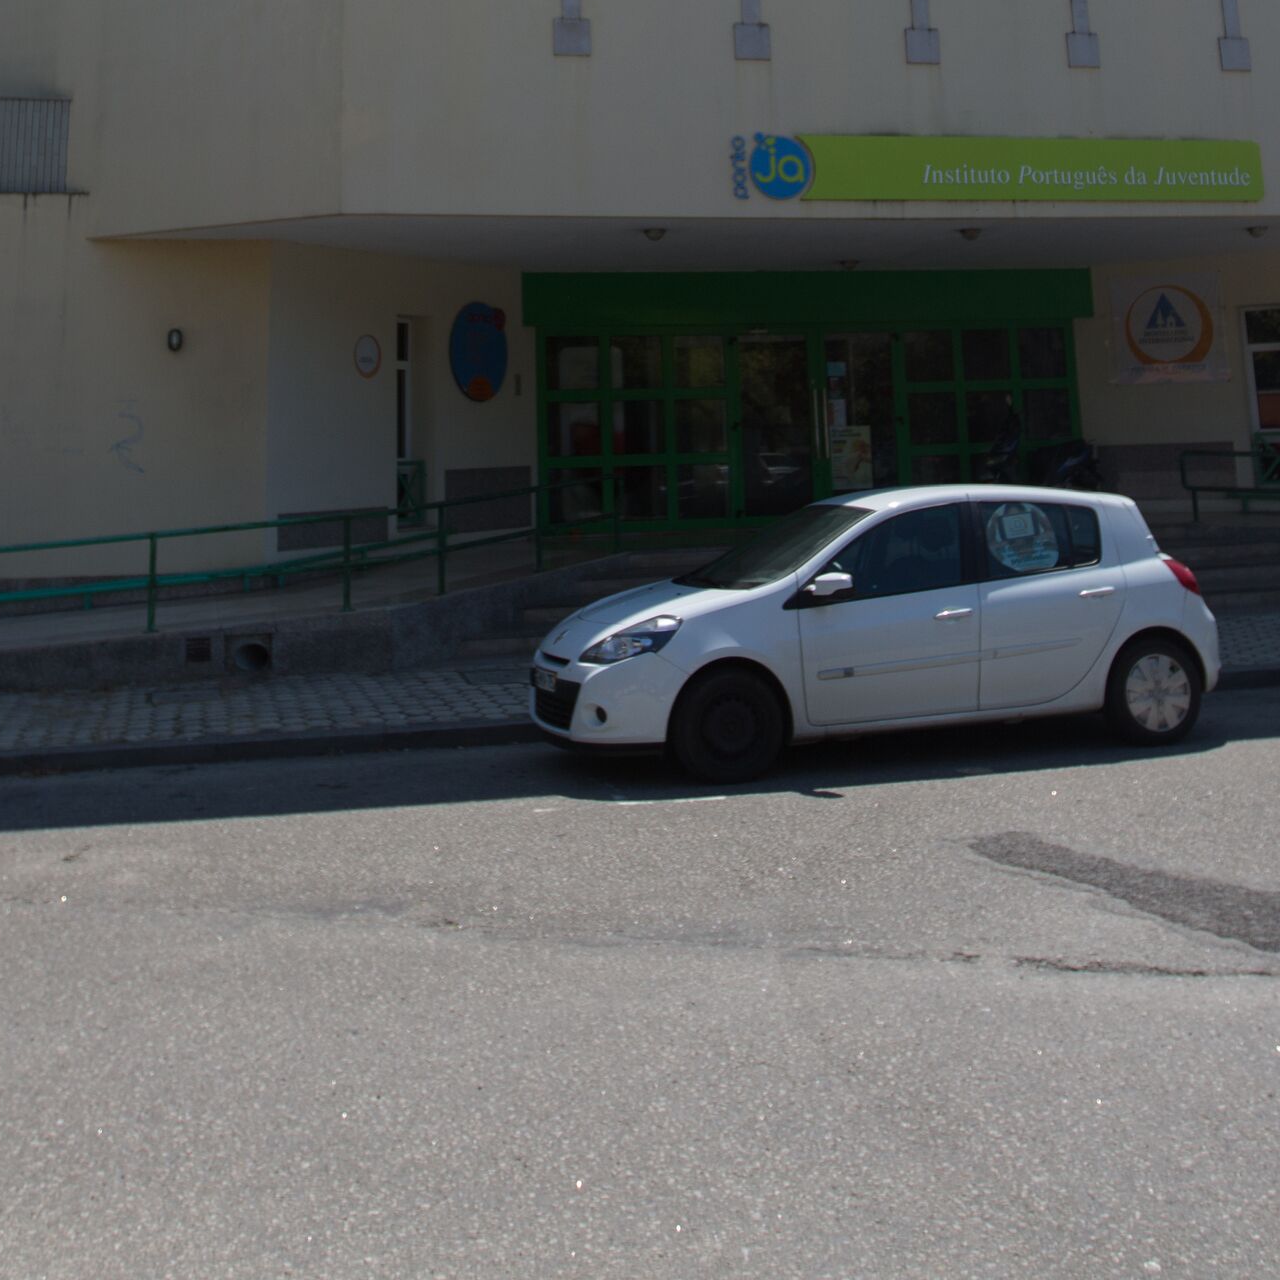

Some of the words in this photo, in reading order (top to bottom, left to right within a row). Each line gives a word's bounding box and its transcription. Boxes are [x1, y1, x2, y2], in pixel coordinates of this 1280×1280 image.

[923, 163, 1010, 185] Instituto
[1019, 165, 1117, 189] Português
[1124, 167, 1147, 186] da
[1154, 167, 1252, 187] Juventude
